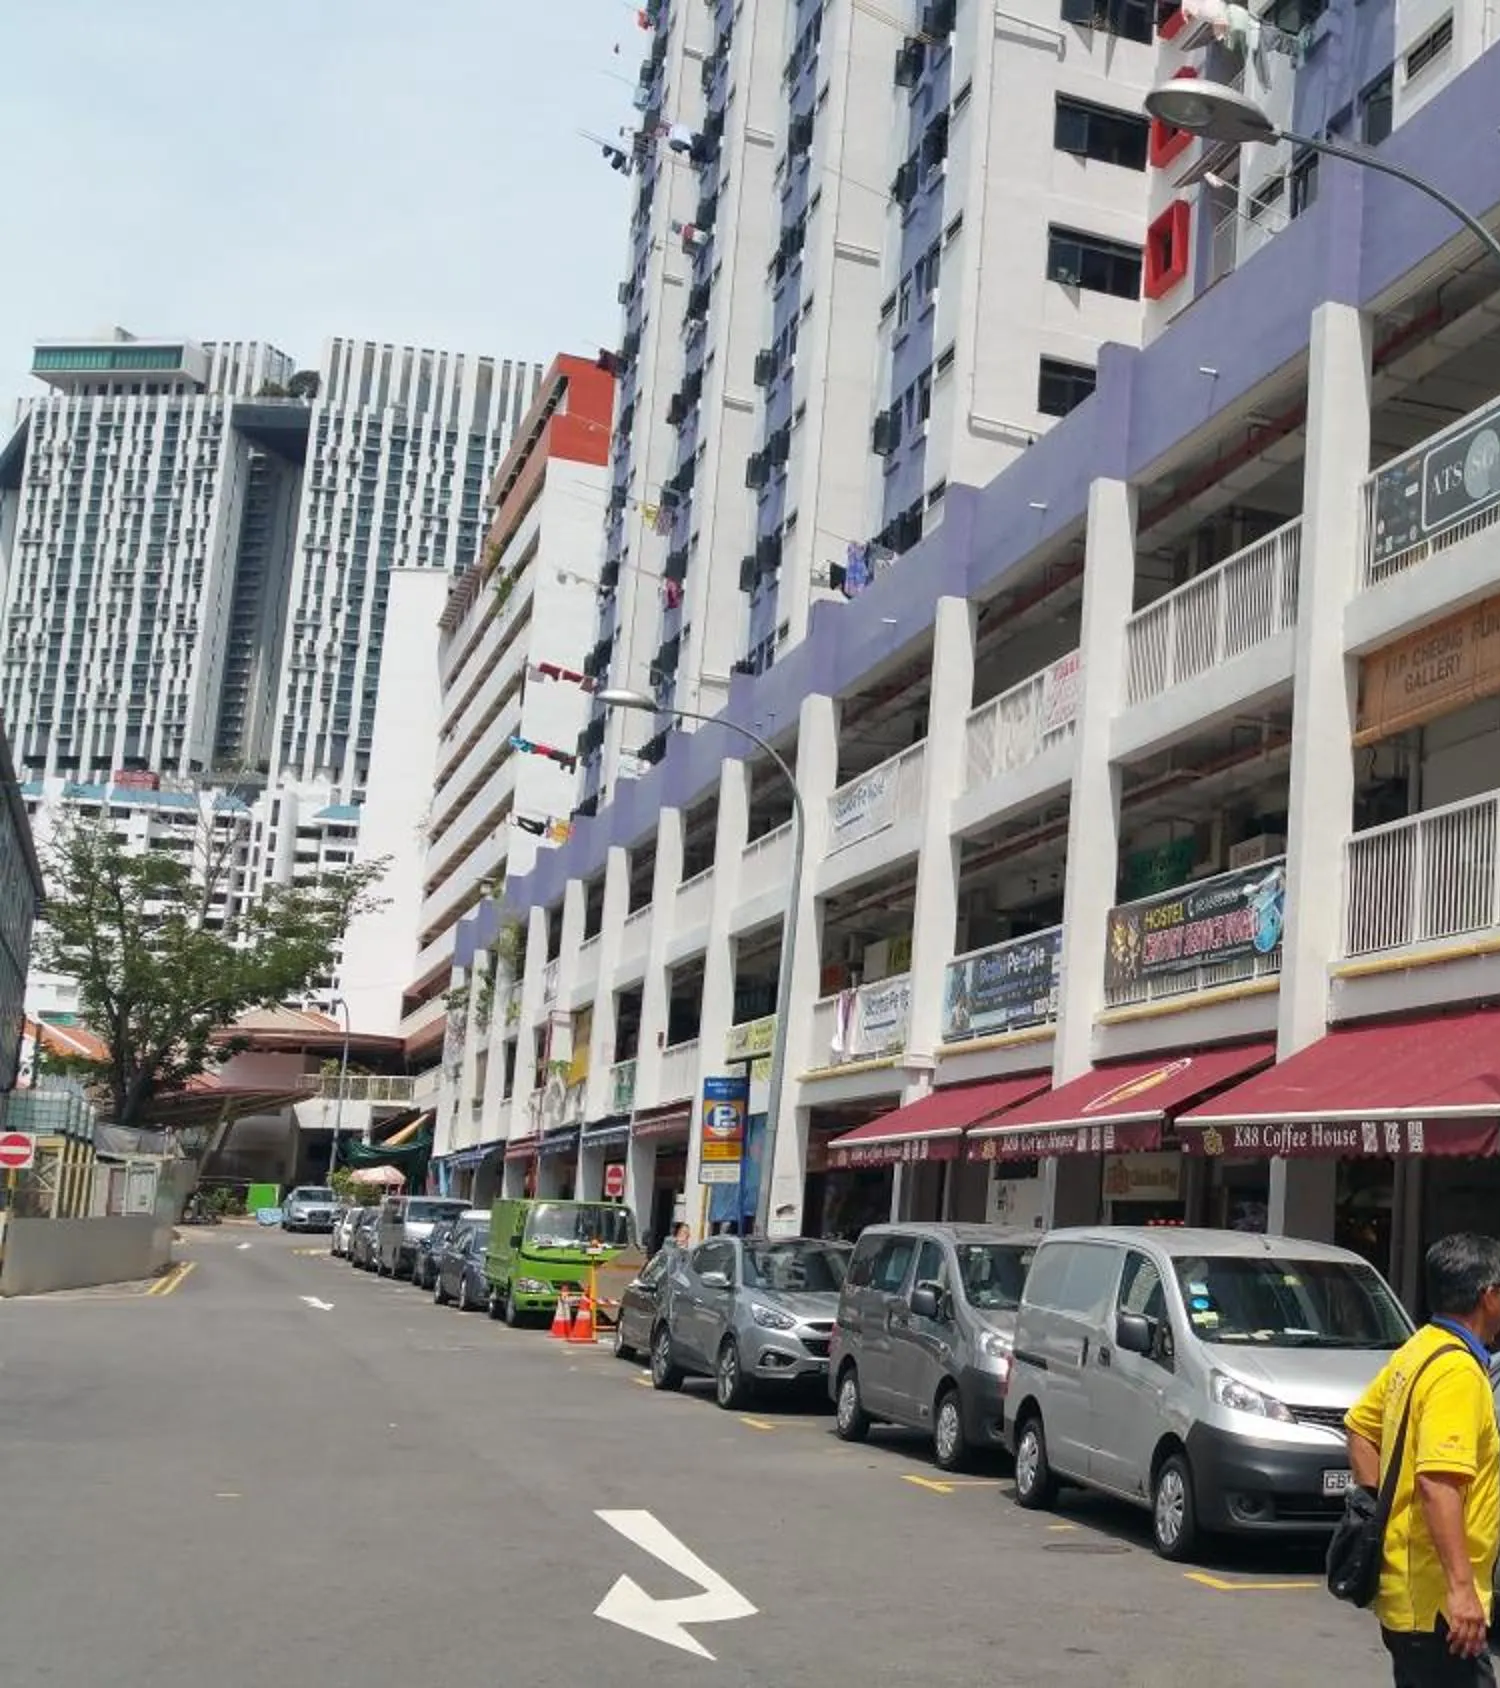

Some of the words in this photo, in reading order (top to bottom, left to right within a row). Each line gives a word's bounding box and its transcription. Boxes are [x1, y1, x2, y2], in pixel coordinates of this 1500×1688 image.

[1431, 461, 1464, 496] ATS
[1404, 652, 1463, 694] GALLERY
[1143, 902, 1185, 930] HOSTEL
[1233, 1125, 1259, 1147] K88
[1263, 1124, 1307, 1153] Coffee
[1311, 1122, 1357, 1148] House
